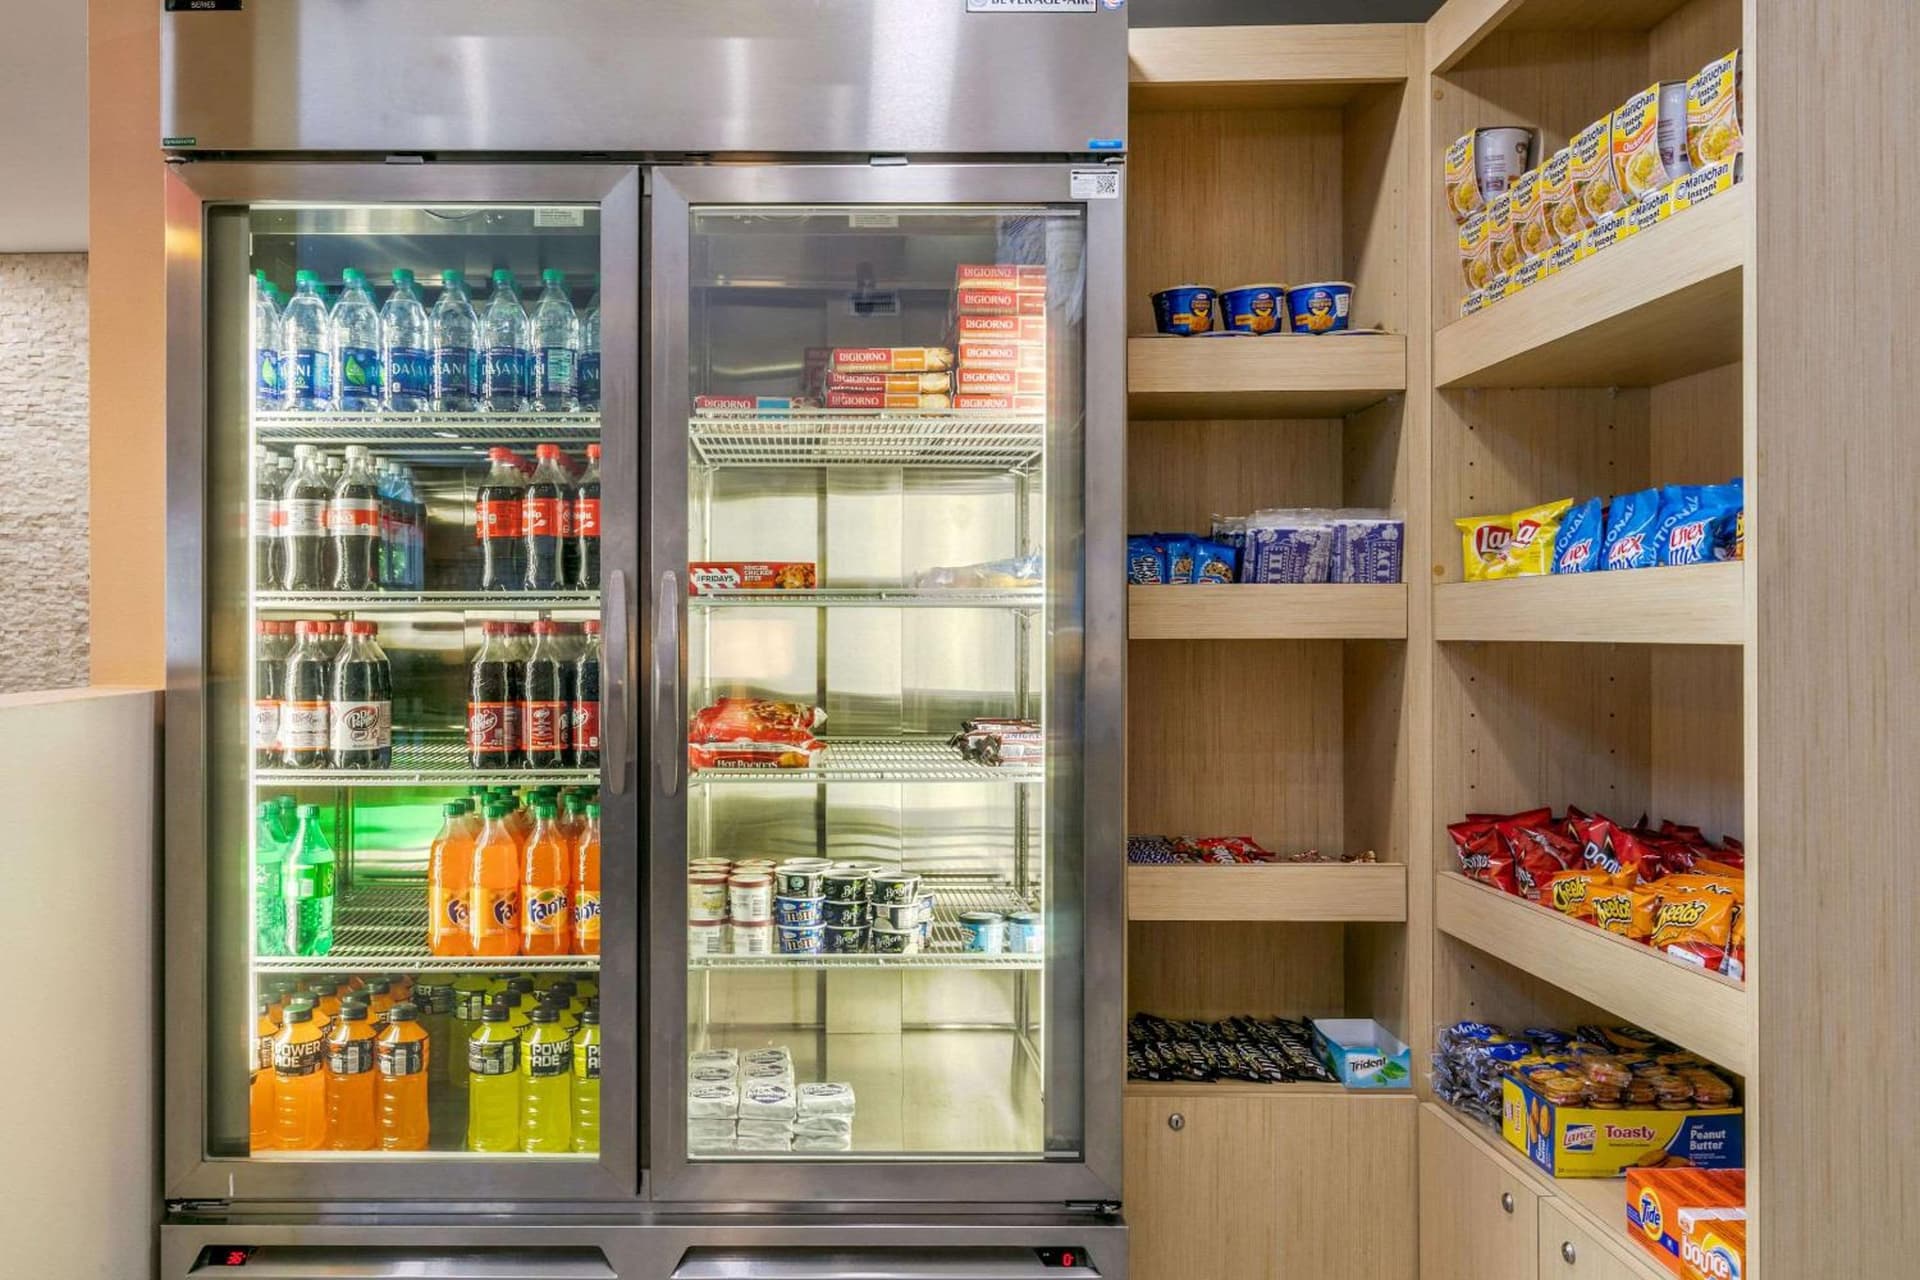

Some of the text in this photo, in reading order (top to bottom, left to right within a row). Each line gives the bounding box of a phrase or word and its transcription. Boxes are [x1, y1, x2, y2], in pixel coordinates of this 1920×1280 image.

[1697, 61, 1731, 85] Maruchan
[1622, 93, 1655, 117] Maruchan
[1686, 164, 1728, 188] Maruchan
[1688, 181, 1716, 200] Instant
[1637, 193, 1669, 214] Maruchan
[964, 268, 1012, 277] DIGIORNO
[965, 295, 1012, 305] DIGIORNO
[966, 319, 1014, 329] DIGIORNO
[839, 353, 887, 362] DIGIORNO
[967, 348, 1013, 358] DIGIORNO
[963, 373, 1010, 382] DIGIORNO
[704, 400, 751, 409] DIGIORNO
[832, 396, 879, 406] DIGIORNO
[960, 399, 1008, 408] DIGIORNO
[529, 897, 567, 922] Fanta
[532, 1055, 560, 1067] ADE
[1350, 1057, 1386, 1072] Trident
[1605, 1125, 1655, 1141] Toasty
[1690, 1130, 1726, 1139] Peanut
[1690, 1140, 1724, 1150] Butter
[1641, 1197, 1660, 1226] Tide
[1681, 1234, 1729, 1279] bounce
